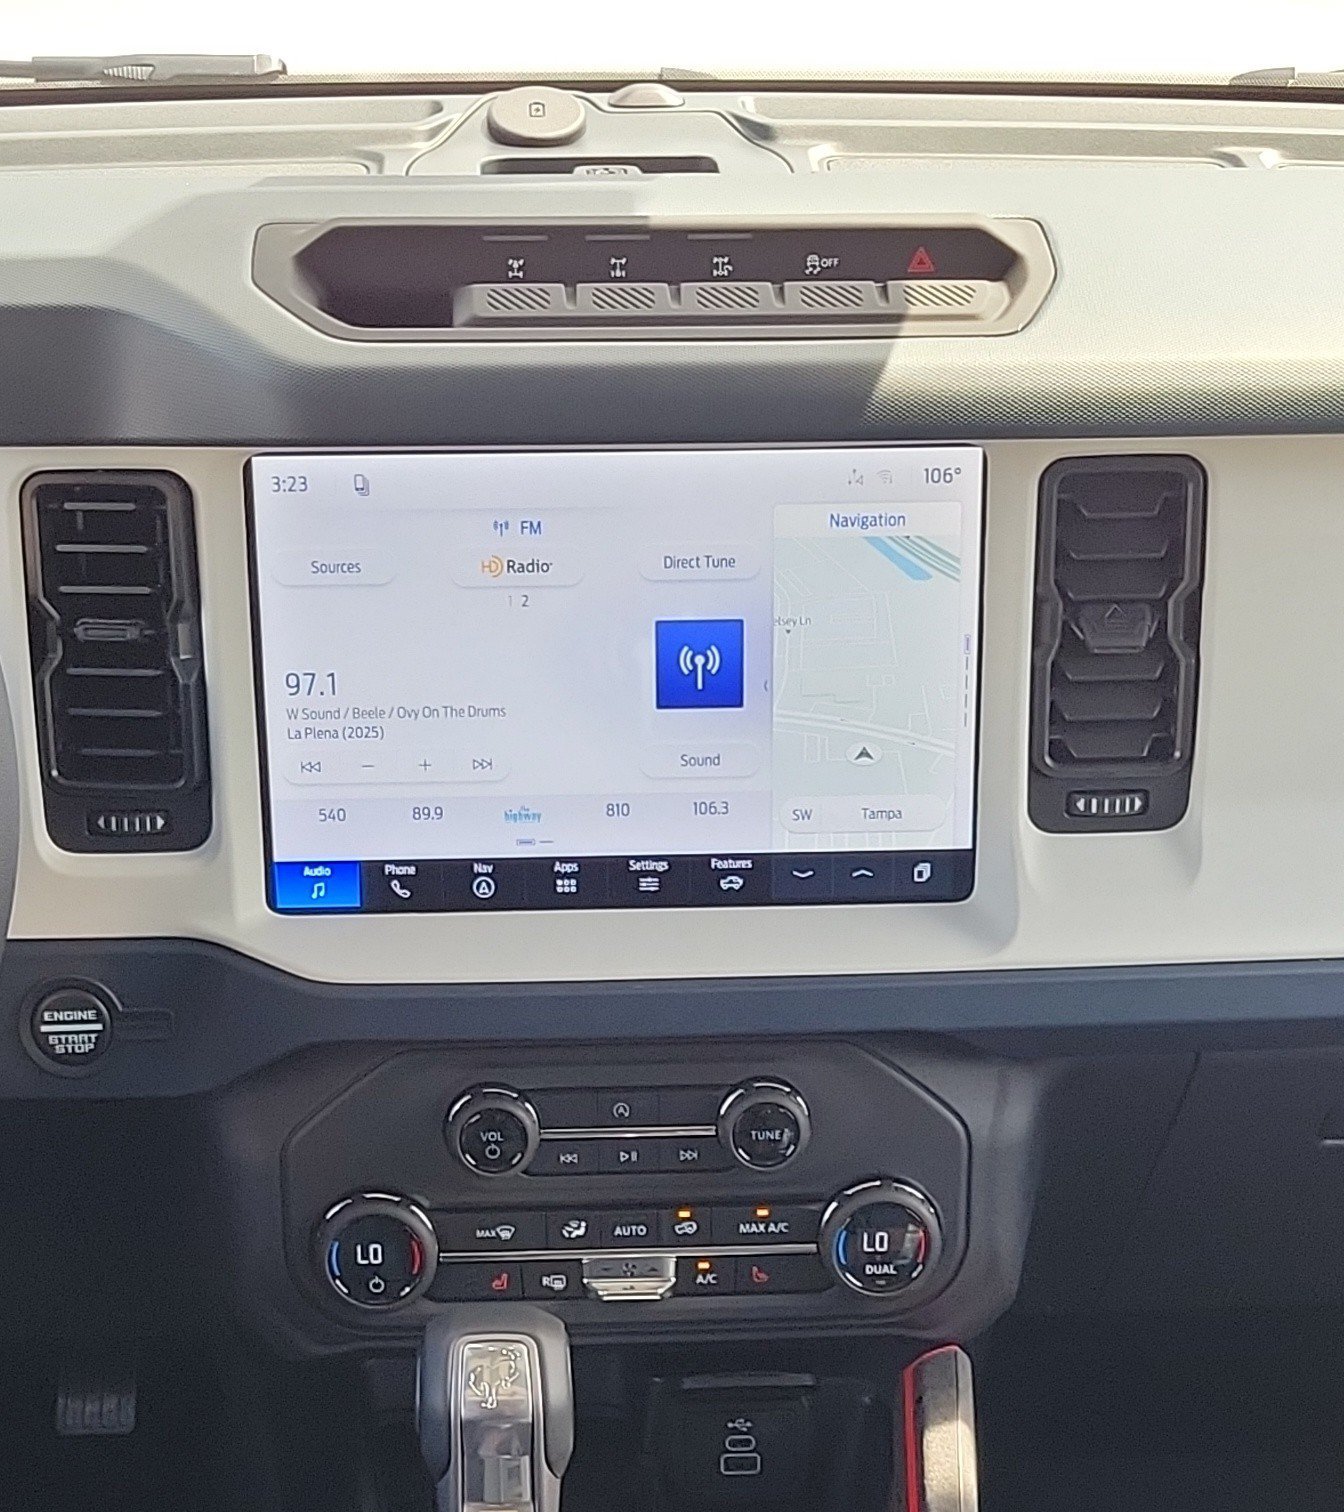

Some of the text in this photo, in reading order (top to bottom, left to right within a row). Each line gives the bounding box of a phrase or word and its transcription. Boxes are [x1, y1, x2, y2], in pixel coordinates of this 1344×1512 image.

[820, 257, 840, 268] OFF
[271, 475, 308, 493] 3:23
[520, 520, 542, 536] FM
[829, 512, 907, 531] Navigation
[310, 560, 362, 575] Sources
[506, 558, 550, 574] Radio
[663, 554, 736, 570] Direct Tune
[520, 593, 530, 608] 2
[285, 672, 338, 696] 97.1
[286, 708, 299, 721] W
[301, 708, 342, 720] Sound
[352, 706, 386, 719] Beele
[397, 706, 420, 720] Ovy
[422, 705, 440, 719] On
[441, 705, 465, 718] The
[468, 704, 507, 718] Drums
[287, 725, 384, 741] La Plena (2025)
[680, 754, 721, 768] Sound
[318, 808, 347, 822] 540
[412, 806, 444, 821] 89.9
[606, 803, 630, 817] 810
[693, 801, 729, 816] 106.3
[792, 809, 812, 821] SW
[861, 807, 903, 821] Tampa
[303, 864, 332, 877] Audio
[384, 864, 417, 876] Phone
[473, 863, 494, 875] Nav
[554, 861, 579, 875] Apps
[628, 860, 669, 873] Settings
[710, 858, 753, 870] Features
[43, 1010, 97, 1021] ENGINE
[48, 1033, 98, 1045] START
[54, 1043, 95, 1054] STOP
[480, 1132, 504, 1143] VOL
[750, 1129, 782, 1141] TUNE
[476, 1229, 496, 1239] MAX
[614, 1223, 647, 1237] AUTO
[739, 1222, 789, 1234] MAX A/C
[862, 1231, 889, 1252] LO
[357, 1243, 383, 1265] LO
[865, 1264, 897, 1276] DUAL
[696, 1273, 718, 1285] A/C
